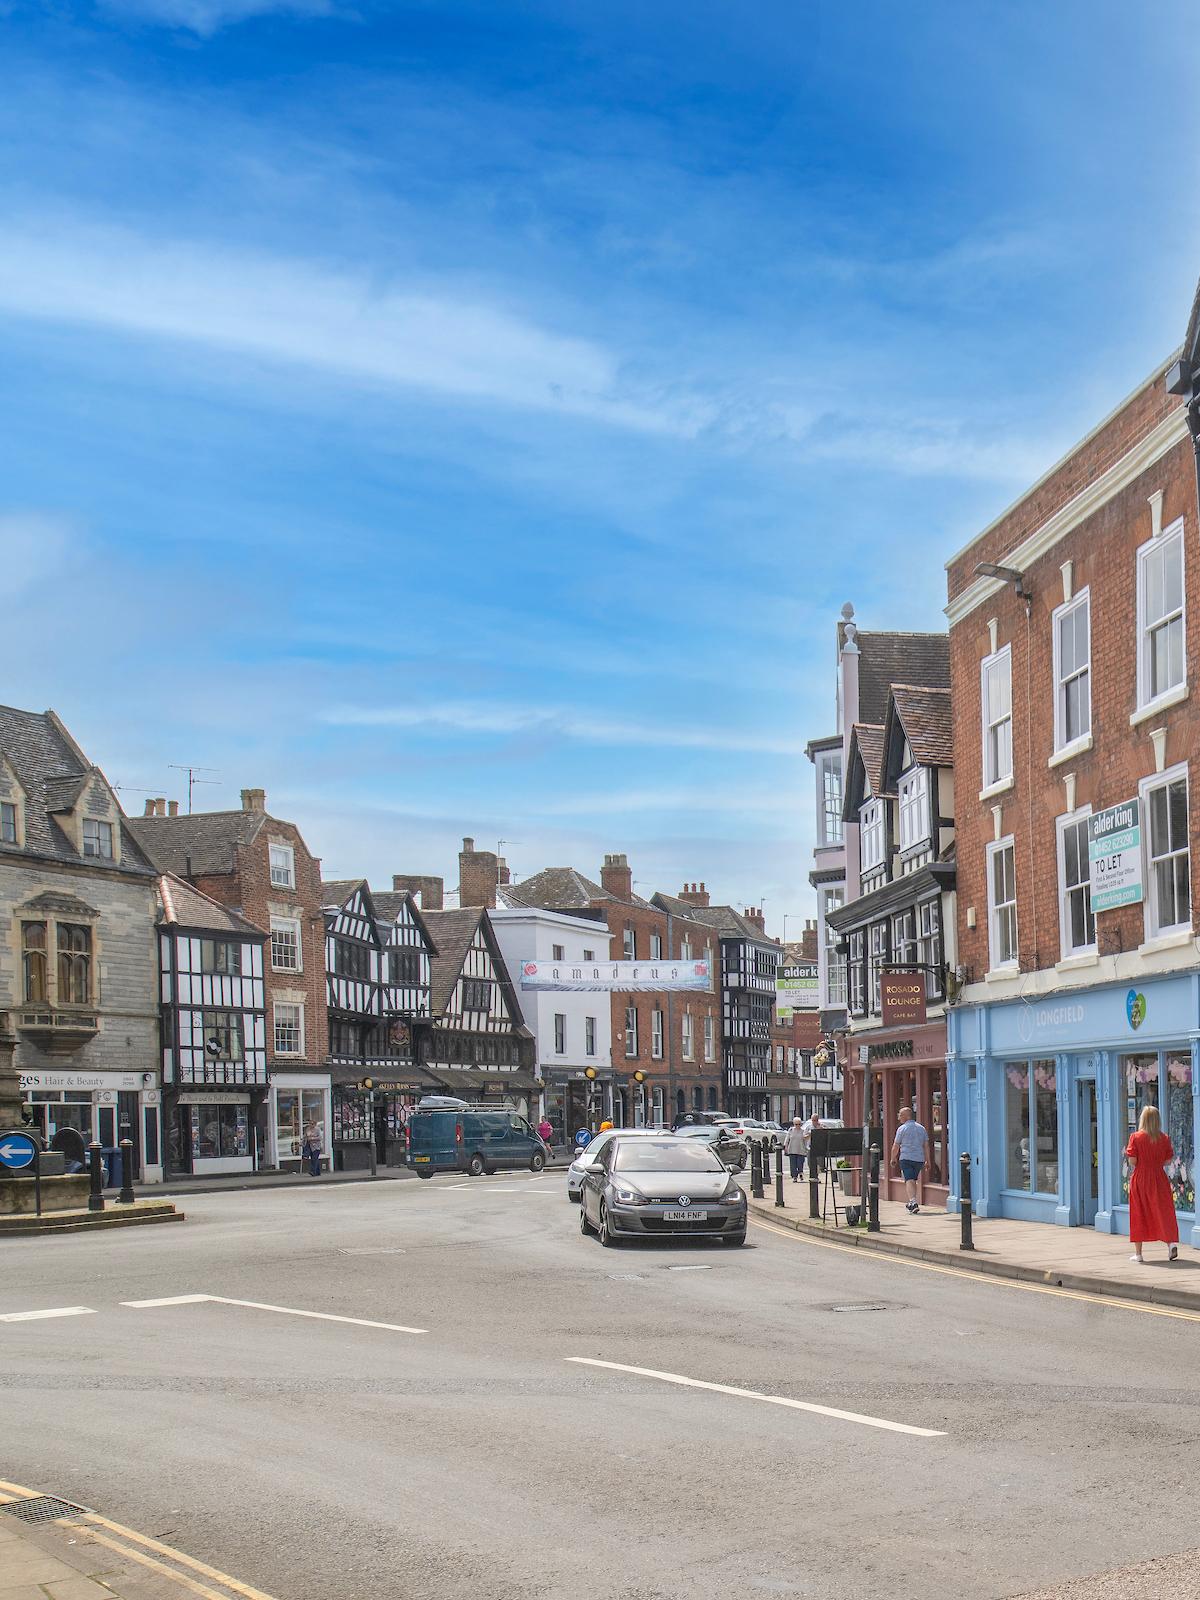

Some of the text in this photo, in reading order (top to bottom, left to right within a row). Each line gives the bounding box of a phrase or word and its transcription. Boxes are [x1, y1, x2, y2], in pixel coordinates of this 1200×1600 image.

[1094, 807, 1133, 834] alder king
[1095, 854, 1122, 873] TO LET
[552, 963, 678, 980] amadeus
[784, 966, 810, 977] alder
[886, 985, 921, 993] ROSADO
[887, 997, 921, 1005] LOUNGE
[1036, 1005, 1084, 1026] LONGFIELD
[45, 1076, 64, 1085] Hair
[66, 1077, 74, 1085] &
[77, 1076, 104, 1087] Beauty
